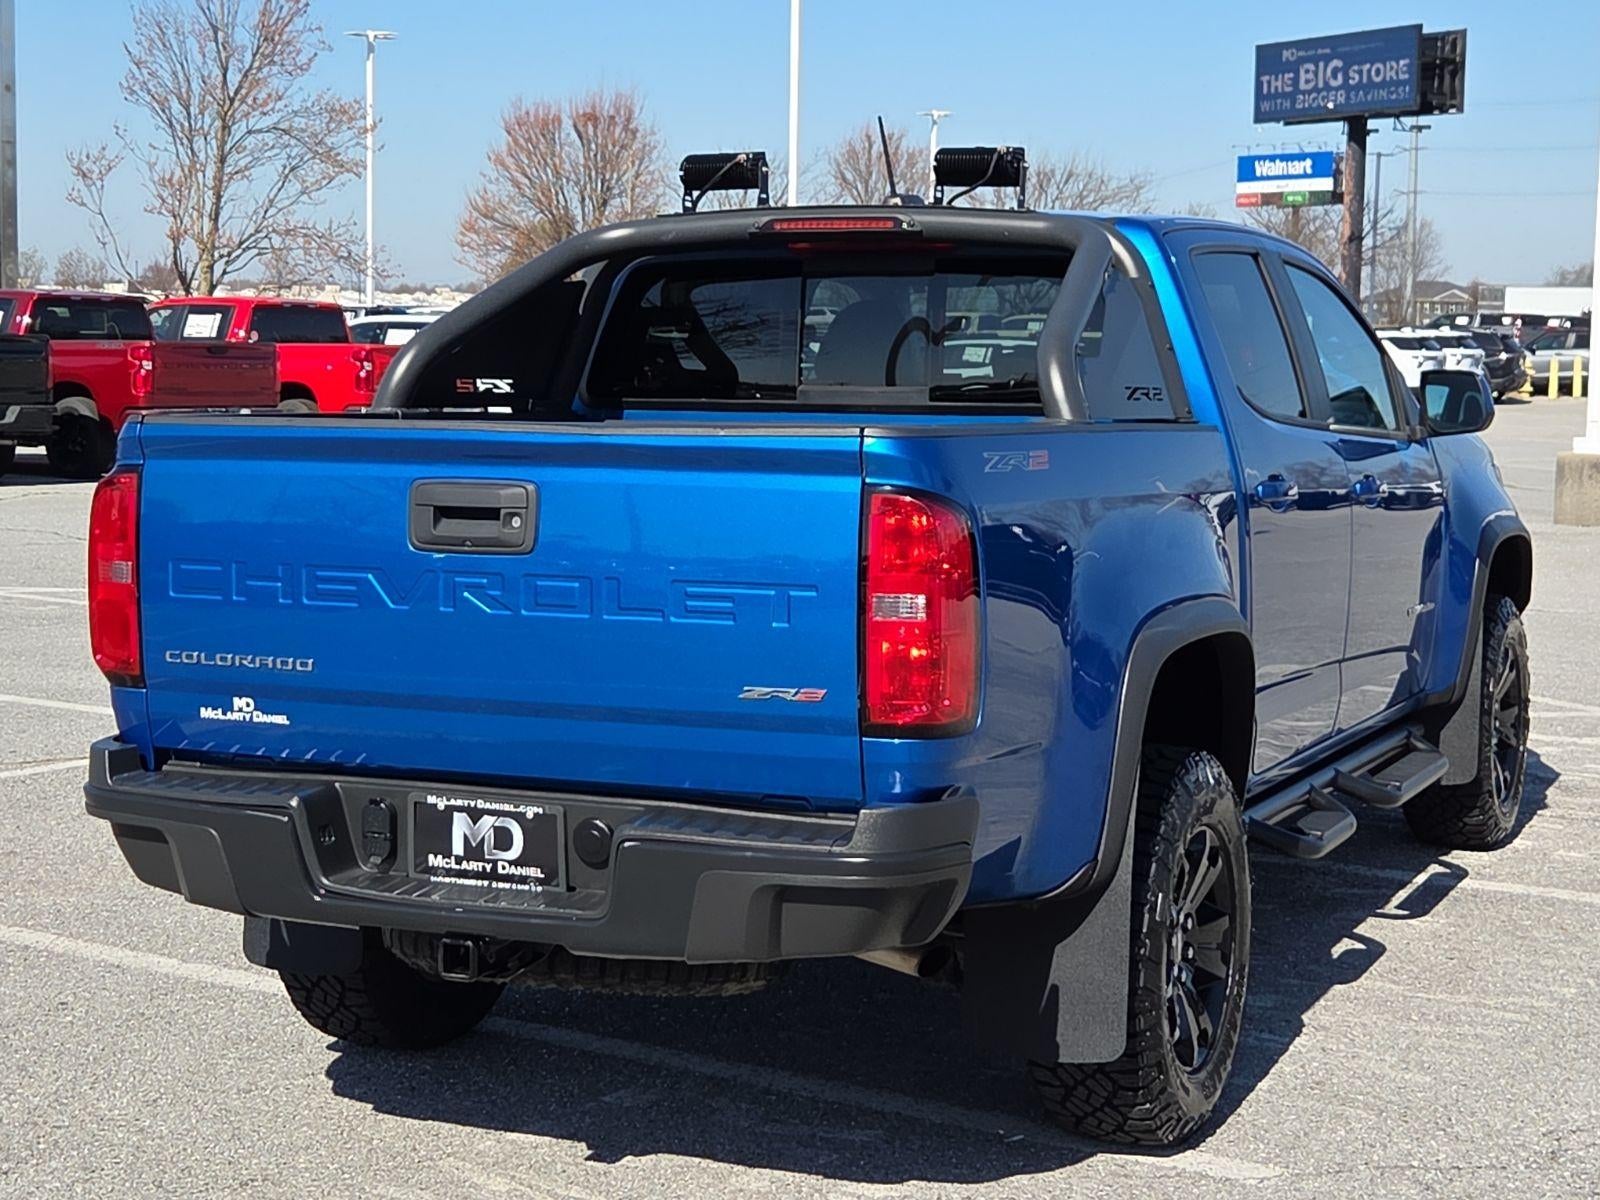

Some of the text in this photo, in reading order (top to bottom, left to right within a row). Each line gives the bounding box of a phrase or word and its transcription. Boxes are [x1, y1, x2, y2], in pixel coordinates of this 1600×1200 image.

[1260, 58, 1410, 95] THE BIG STORE
[1260, 98, 1291, 112] WITH
[1295, 90, 1346, 109] BIGGER
[1254, 157, 1313, 177] Walmart
[1124, 386, 1163, 401] ZR2
[982, 449, 1049, 473] ZR2
[167, 558, 818, 627] CHEVROLET
[165, 650, 314, 672] COLORADO
[232, 696, 255, 712] MD
[738, 686, 828, 702] ZR2
[451, 811, 524, 861] MD
[497, 861, 546, 878] DANIEL
